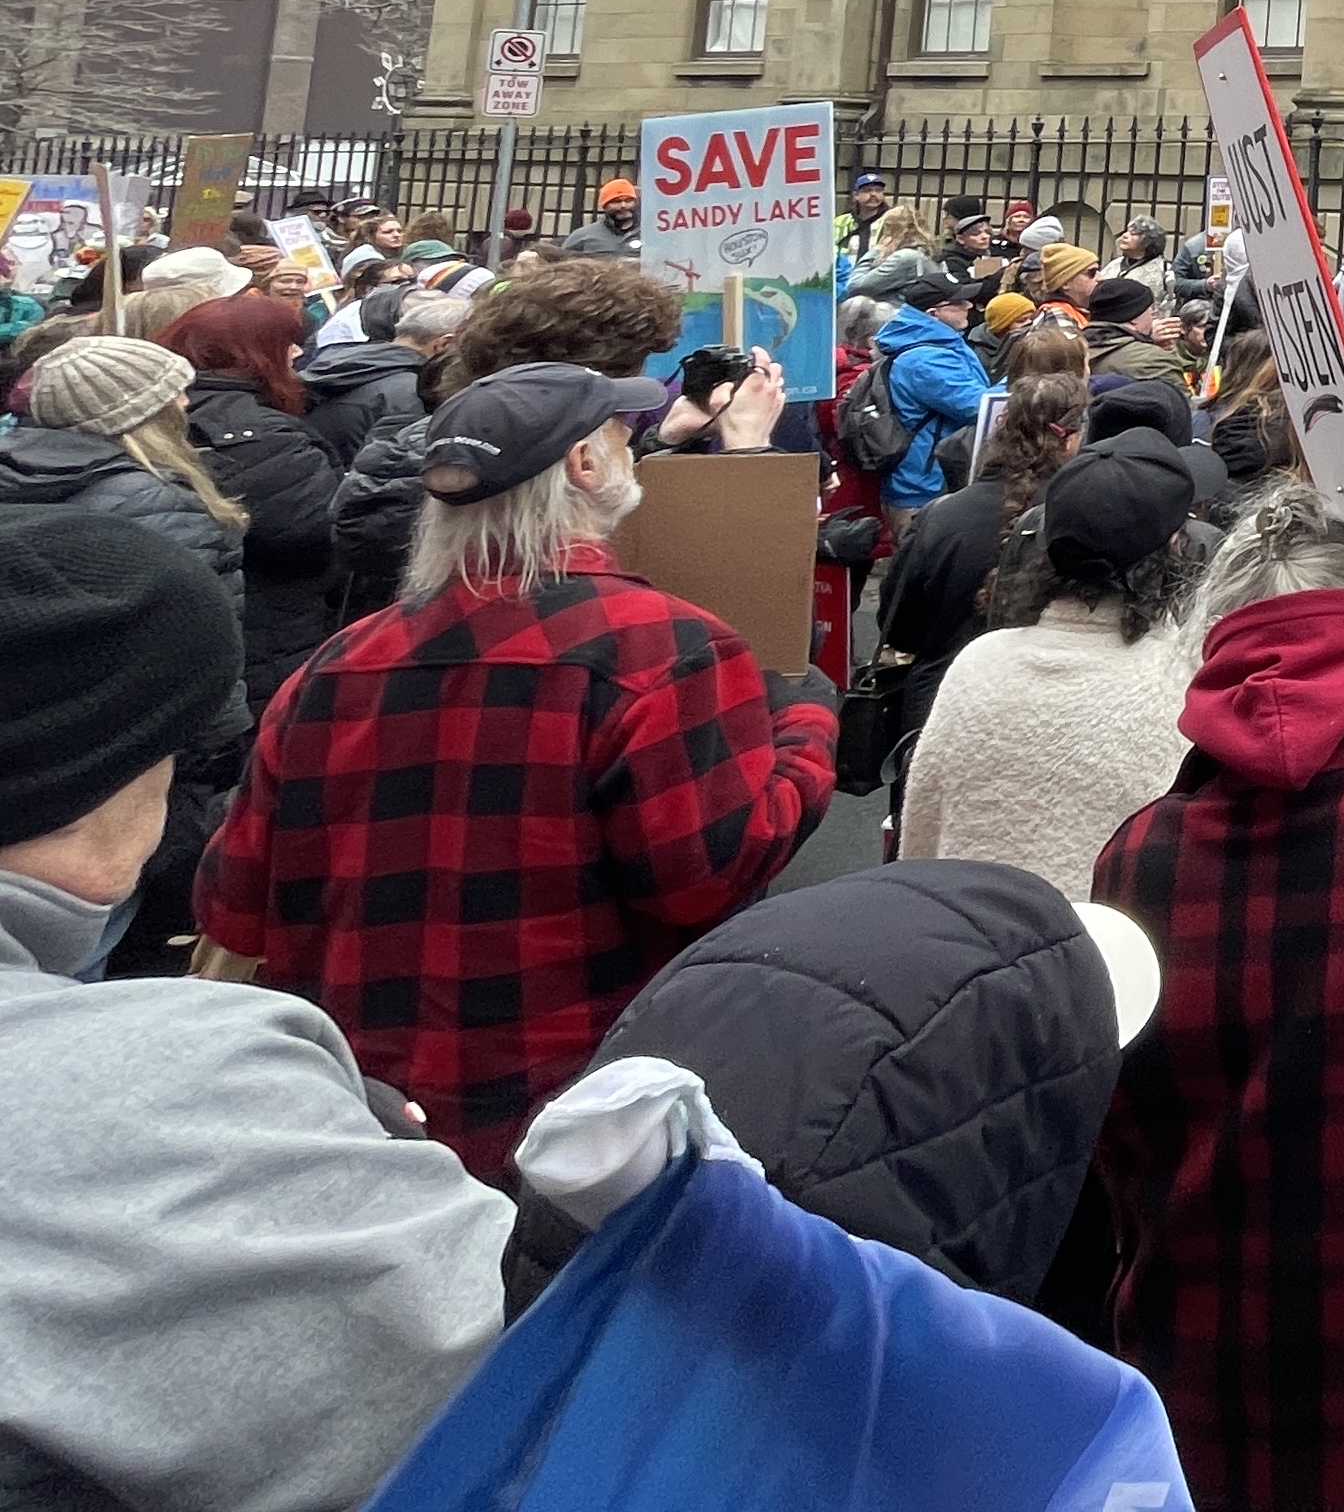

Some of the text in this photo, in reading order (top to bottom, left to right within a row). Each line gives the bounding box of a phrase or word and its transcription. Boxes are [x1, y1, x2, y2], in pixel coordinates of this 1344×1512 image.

[491, 90, 532, 99] AWAY
[499, 79, 530, 88] TOW
[493, 100, 529, 110] ZONE
[655, 123, 821, 196] SAVE
[1227, 123, 1288, 235] JUST
[656, 195, 821, 232] SANDY LAKE
